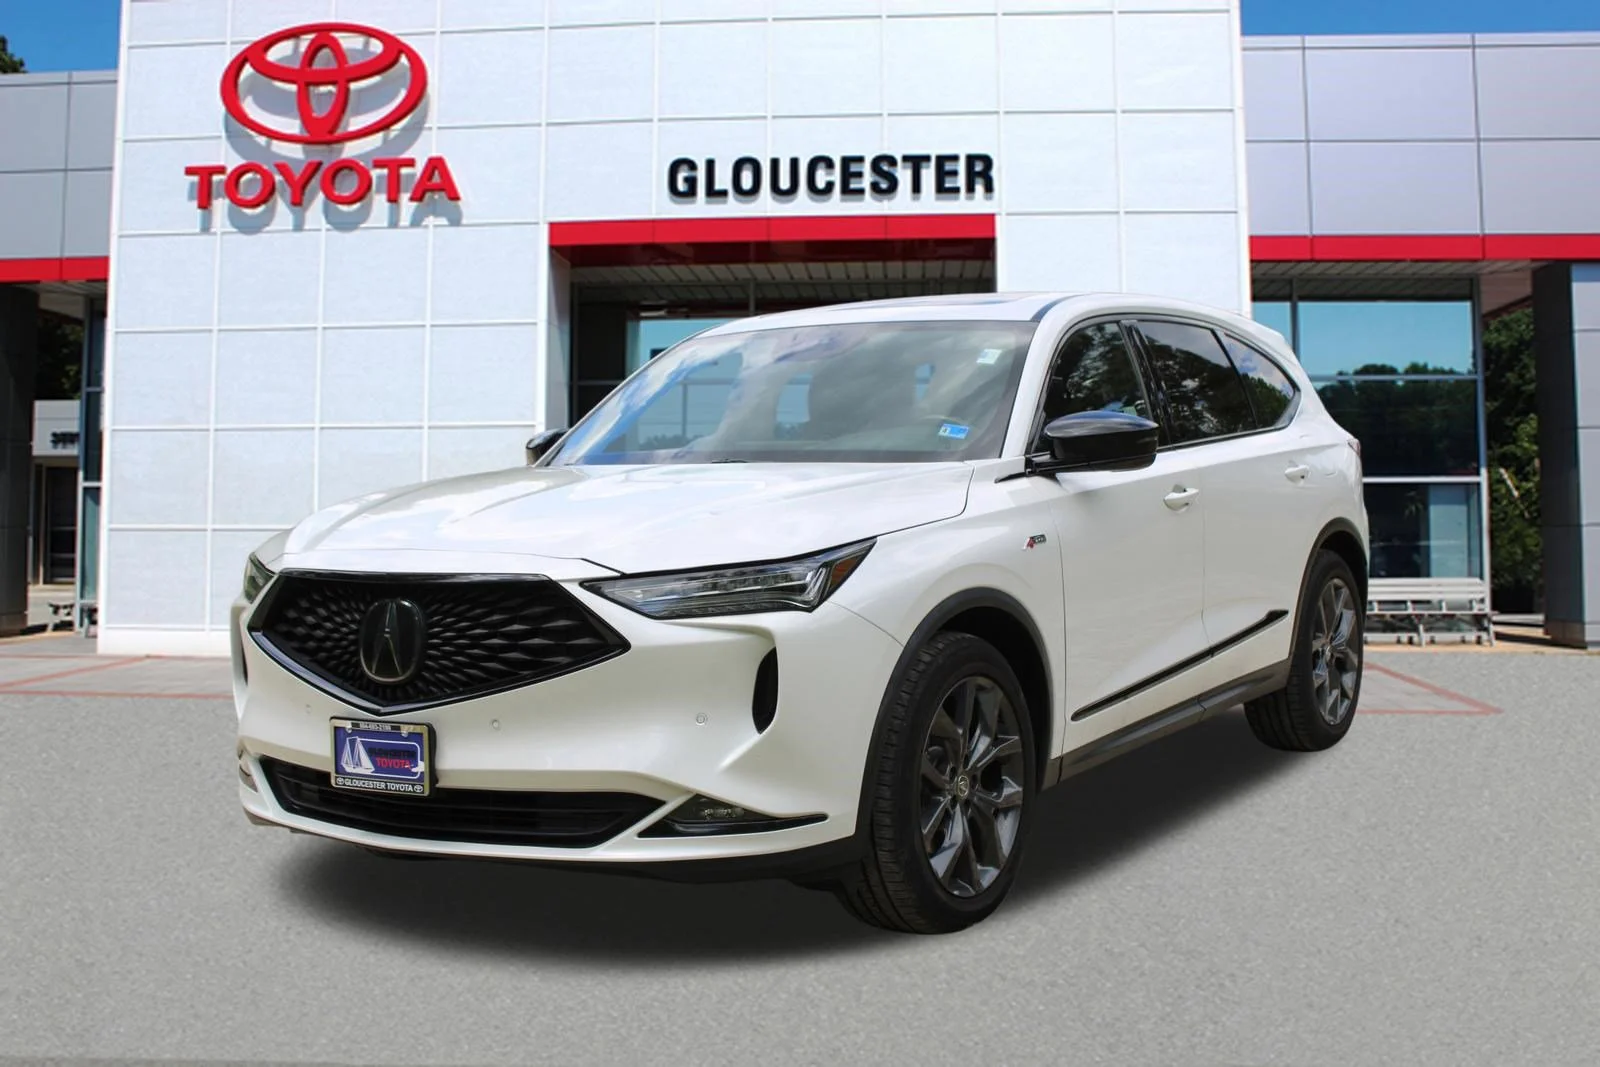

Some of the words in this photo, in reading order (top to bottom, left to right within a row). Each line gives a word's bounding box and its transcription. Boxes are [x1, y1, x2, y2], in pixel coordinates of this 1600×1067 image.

[184, 156, 461, 209] TOYOTA
[667, 153, 994, 198] GLOUCESTER
[376, 757, 411, 769] TOYOTA
[344, 778, 386, 789] GLOUCESTER
[387, 783, 413, 792] TOYOTA
